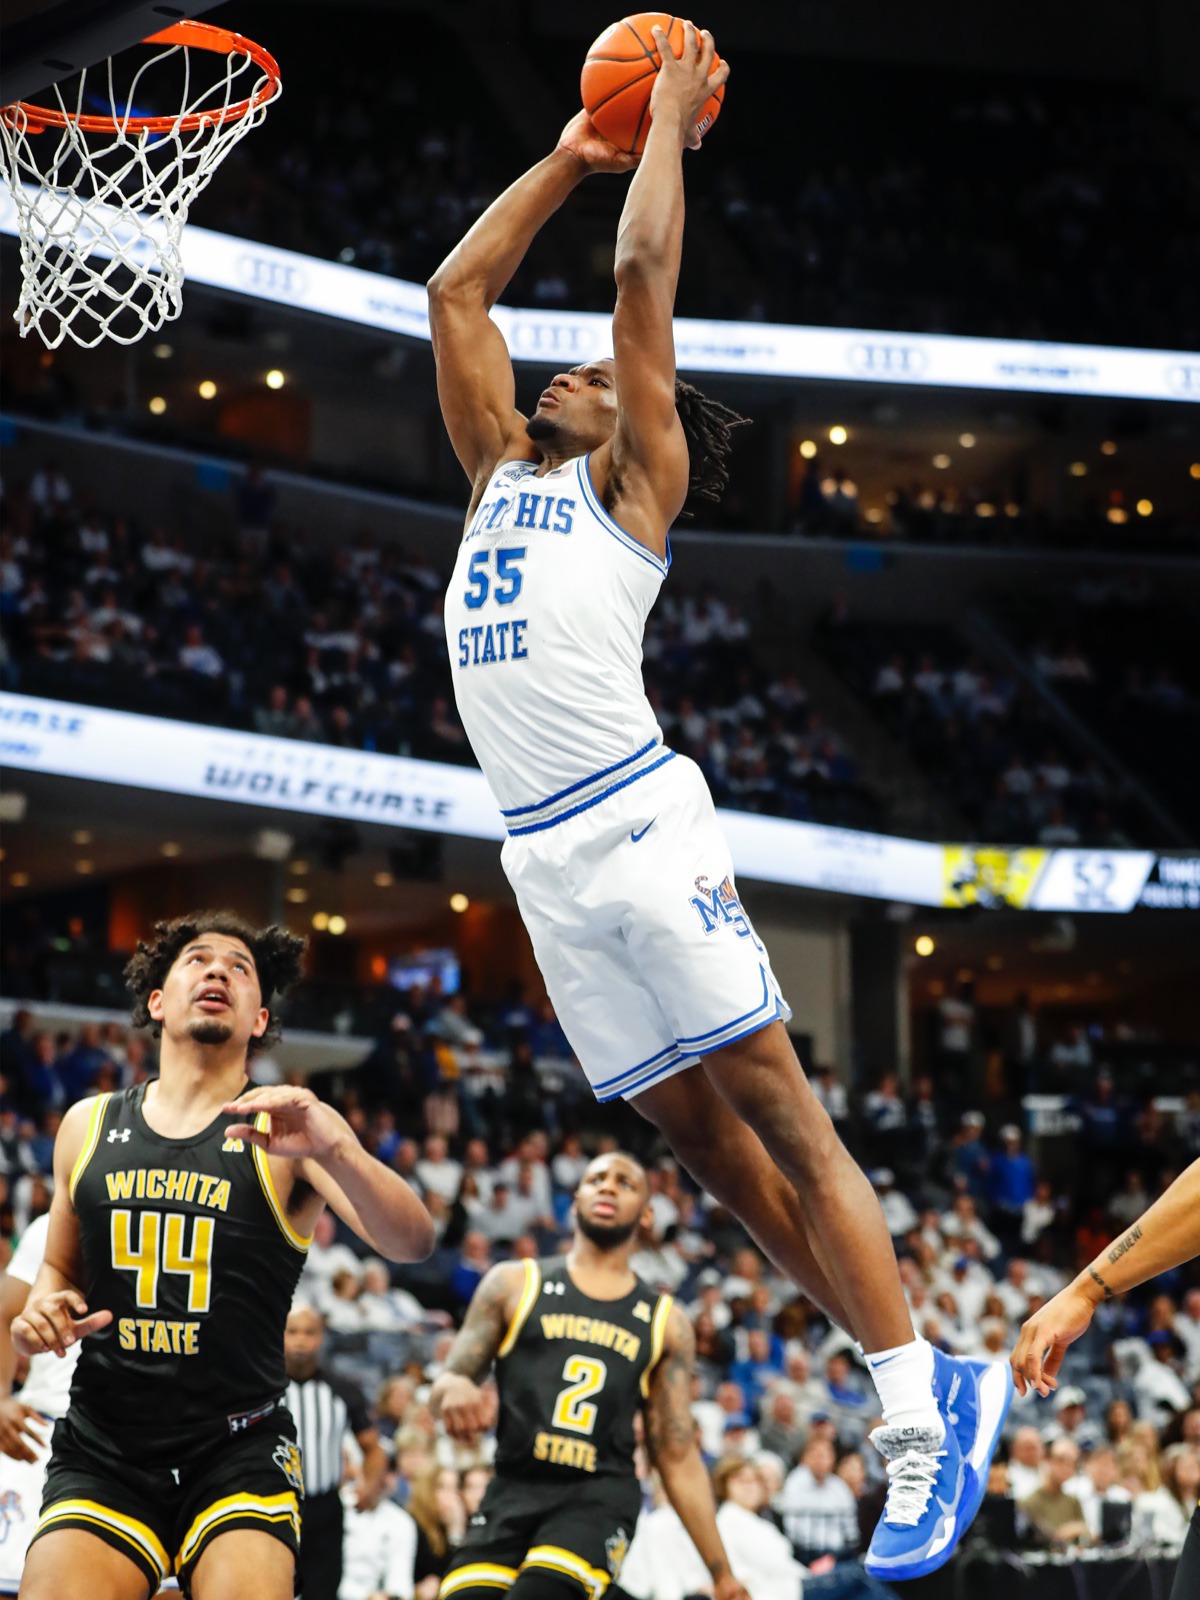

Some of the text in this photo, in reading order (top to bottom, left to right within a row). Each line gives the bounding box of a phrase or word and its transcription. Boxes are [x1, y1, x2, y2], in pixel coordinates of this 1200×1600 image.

[464, 546, 528, 612] 55
[459, 619, 529, 669] STATE
[105, 1169, 231, 1211] WICHITA
[111, 1209, 215, 1312] 44
[119, 1318, 200, 1355] STATE
[540, 1313, 641, 1362] WICHITA
[552, 1354, 607, 1435] 2
[534, 1431, 597, 1473] STATE
